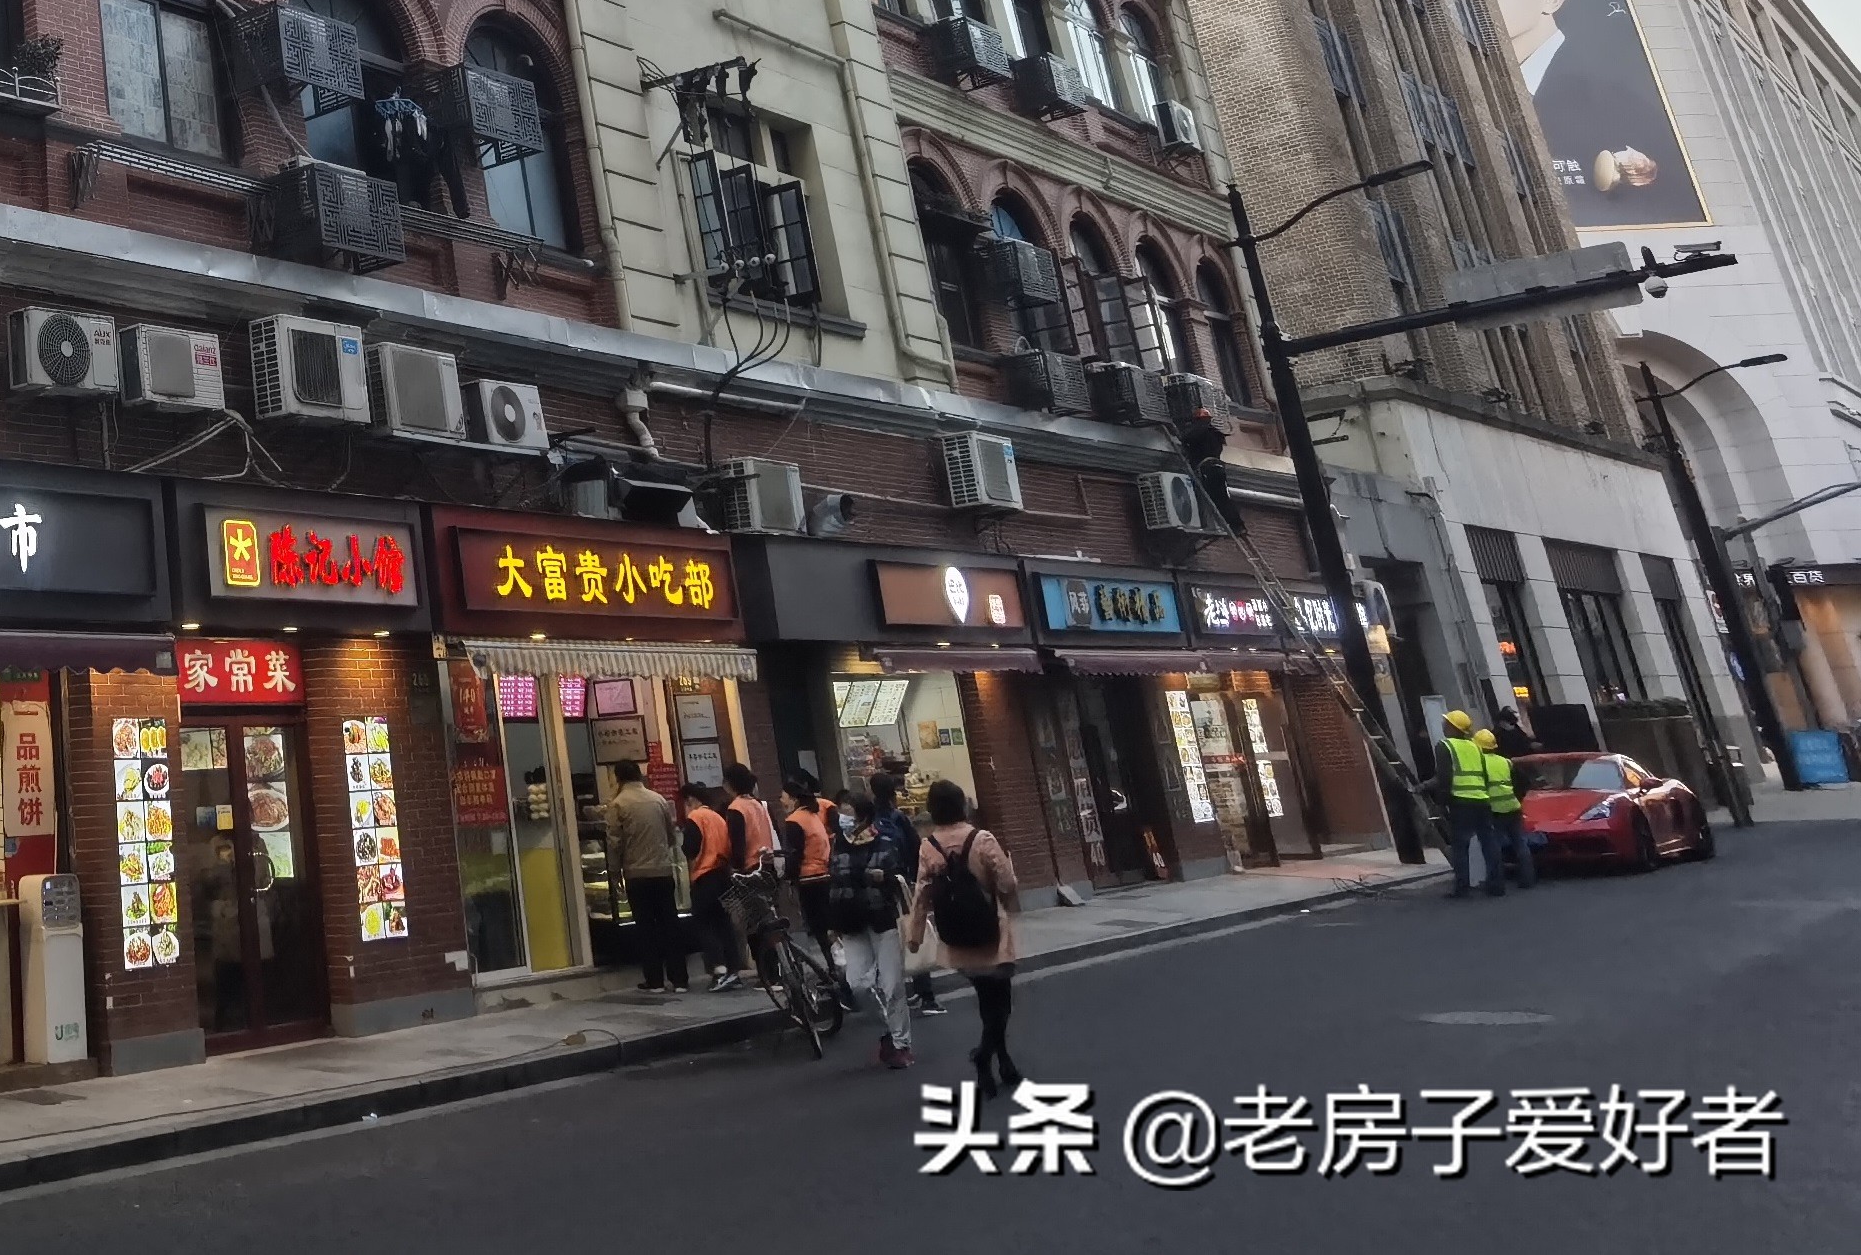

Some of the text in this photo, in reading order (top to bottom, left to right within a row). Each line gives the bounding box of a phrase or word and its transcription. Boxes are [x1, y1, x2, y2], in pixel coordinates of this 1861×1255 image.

[93, 329, 112, 337] AUX
[496, 545, 714, 610] 大富贵小吃部
[183, 648, 296, 693] 家常菜
[13, 710, 44, 826] 一品煎饼
